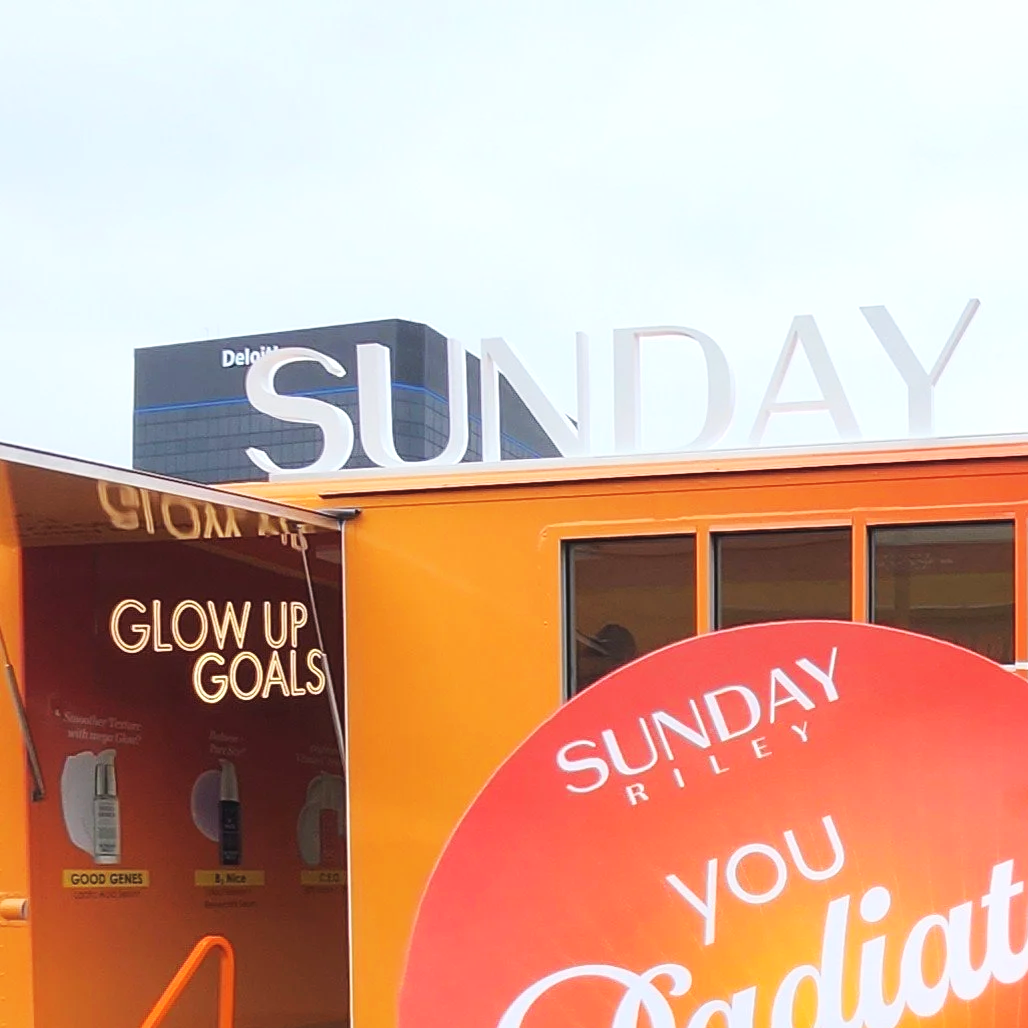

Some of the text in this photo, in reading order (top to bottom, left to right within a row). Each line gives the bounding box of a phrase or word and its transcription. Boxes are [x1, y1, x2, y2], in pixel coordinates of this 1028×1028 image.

[222, 345, 279, 367] Deloi
[243, 297, 982, 475] SUNDAY
[110, 600, 308, 654] GLOW UP
[193, 648, 327, 703] GOALS
[557, 646, 839, 794] SUNDAY
[626, 721, 810, 806] RILEY
[71, 873, 143, 887] GOOD GENES
